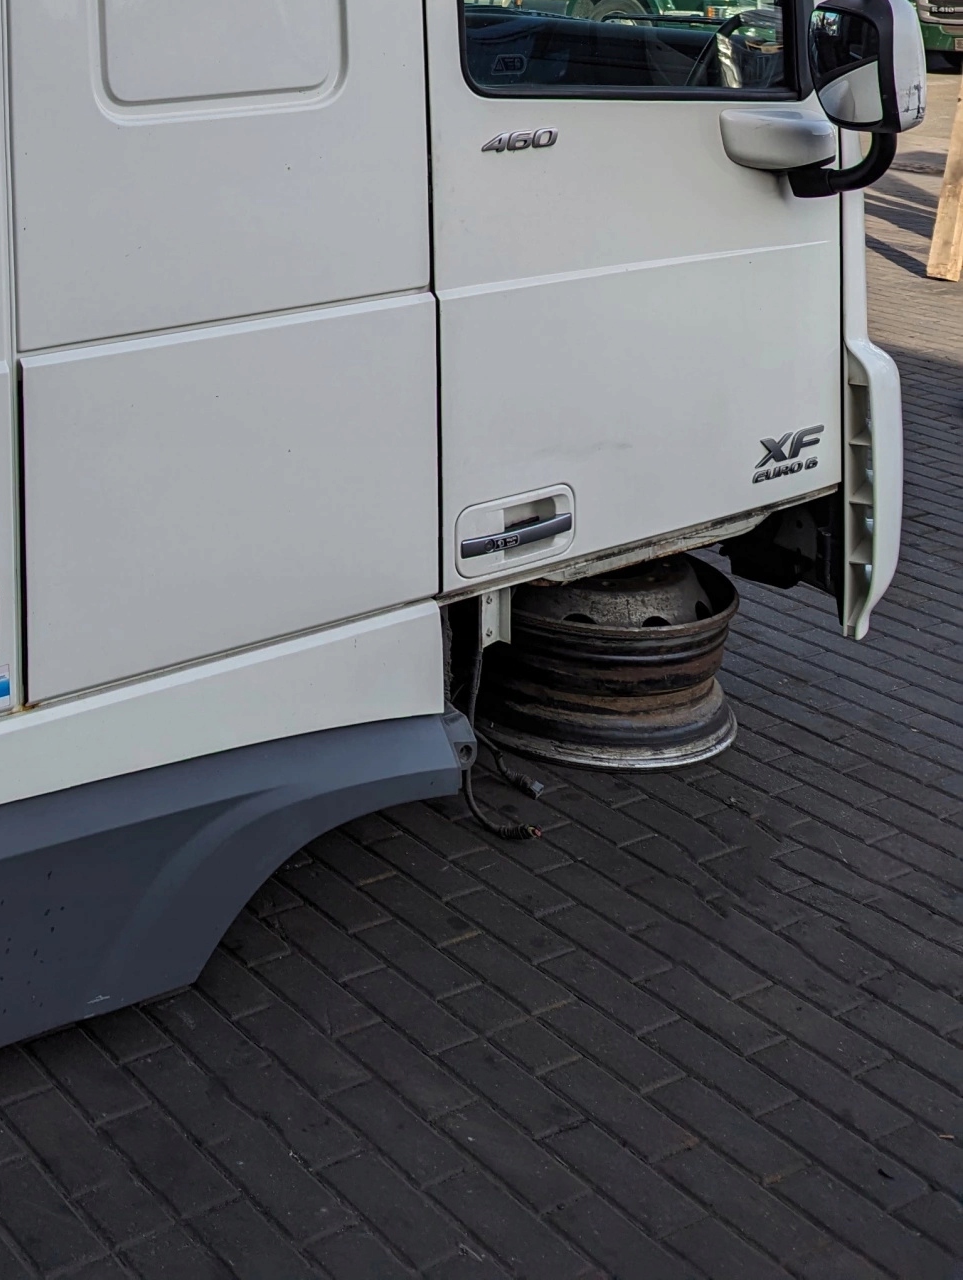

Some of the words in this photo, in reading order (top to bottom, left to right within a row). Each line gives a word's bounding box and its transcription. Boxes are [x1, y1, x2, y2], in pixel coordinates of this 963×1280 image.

[481, 127, 558, 152] 460
[755, 424, 825, 468] XF
[752, 461, 803, 484] EURO
[805, 456, 819, 470] 6
